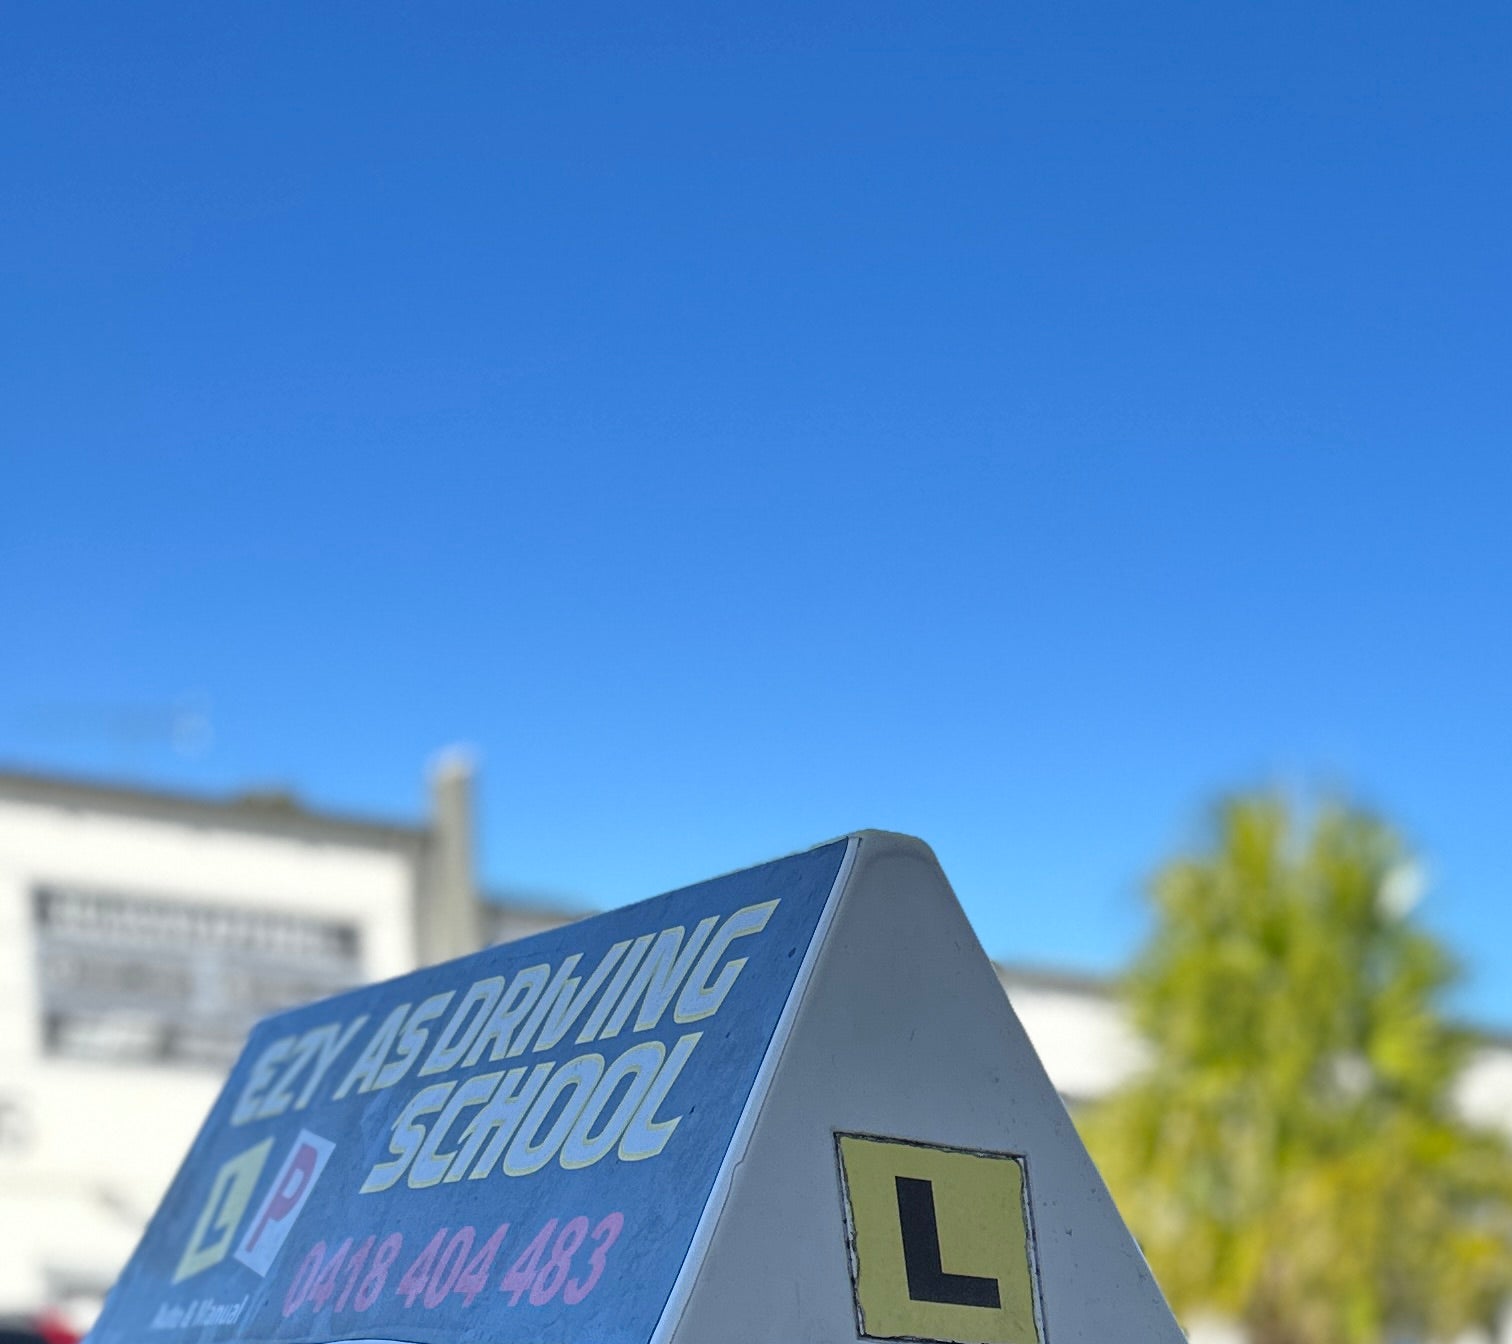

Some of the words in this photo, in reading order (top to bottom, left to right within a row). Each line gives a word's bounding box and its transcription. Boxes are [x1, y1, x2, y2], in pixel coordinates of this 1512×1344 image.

[231, 1013, 370, 1126] EZY
[332, 990, 456, 1100] AS
[418, 898, 781, 1077] DRIVING
[359, 1031, 704, 1194] SCHOOL
[246, 1142, 318, 1253] P
[282, 1232, 403, 1318] 0418
[396, 1223, 510, 1309] 404
[500, 1211, 624, 1307] 483
[895, 1175, 1001, 1309] L
